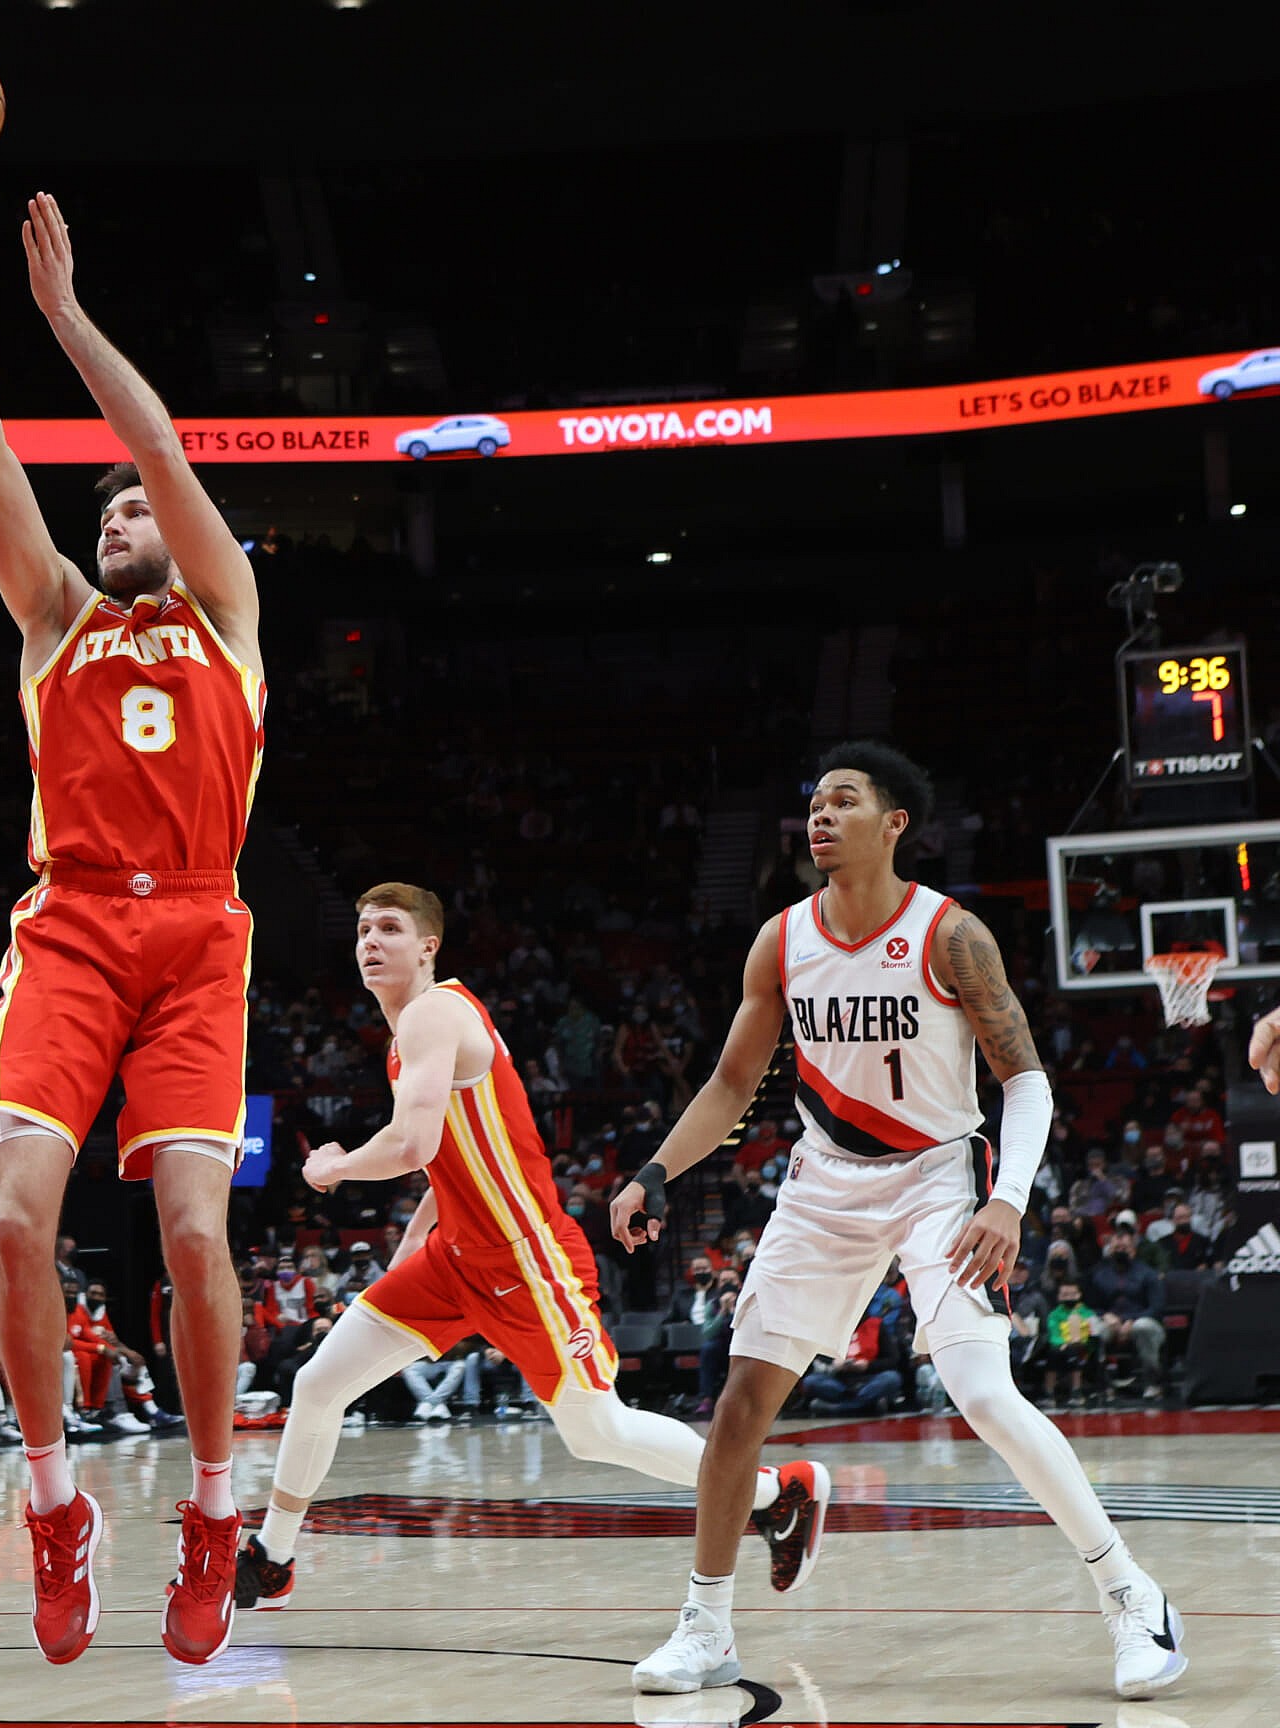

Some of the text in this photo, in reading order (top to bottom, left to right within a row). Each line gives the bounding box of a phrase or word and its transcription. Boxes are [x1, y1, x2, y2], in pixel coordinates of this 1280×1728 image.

[959, 375, 1170, 417] LET'S GO BLAZER
[182, 430, 369, 450] ET'S GO BLAZER
[558, 406, 772, 445] TOYOTA.COM
[67, 624, 211, 676] ATLANTA
[1158, 656, 1230, 694] 9:36
[121, 686, 177, 752] 8
[1192, 690, 1224, 742] 7
[1164, 752, 1243, 775] TISSOT
[880, 960, 912, 968] StormX
[791, 995, 919, 1043] BLAZERS
[883, 1048, 904, 1101] 1
